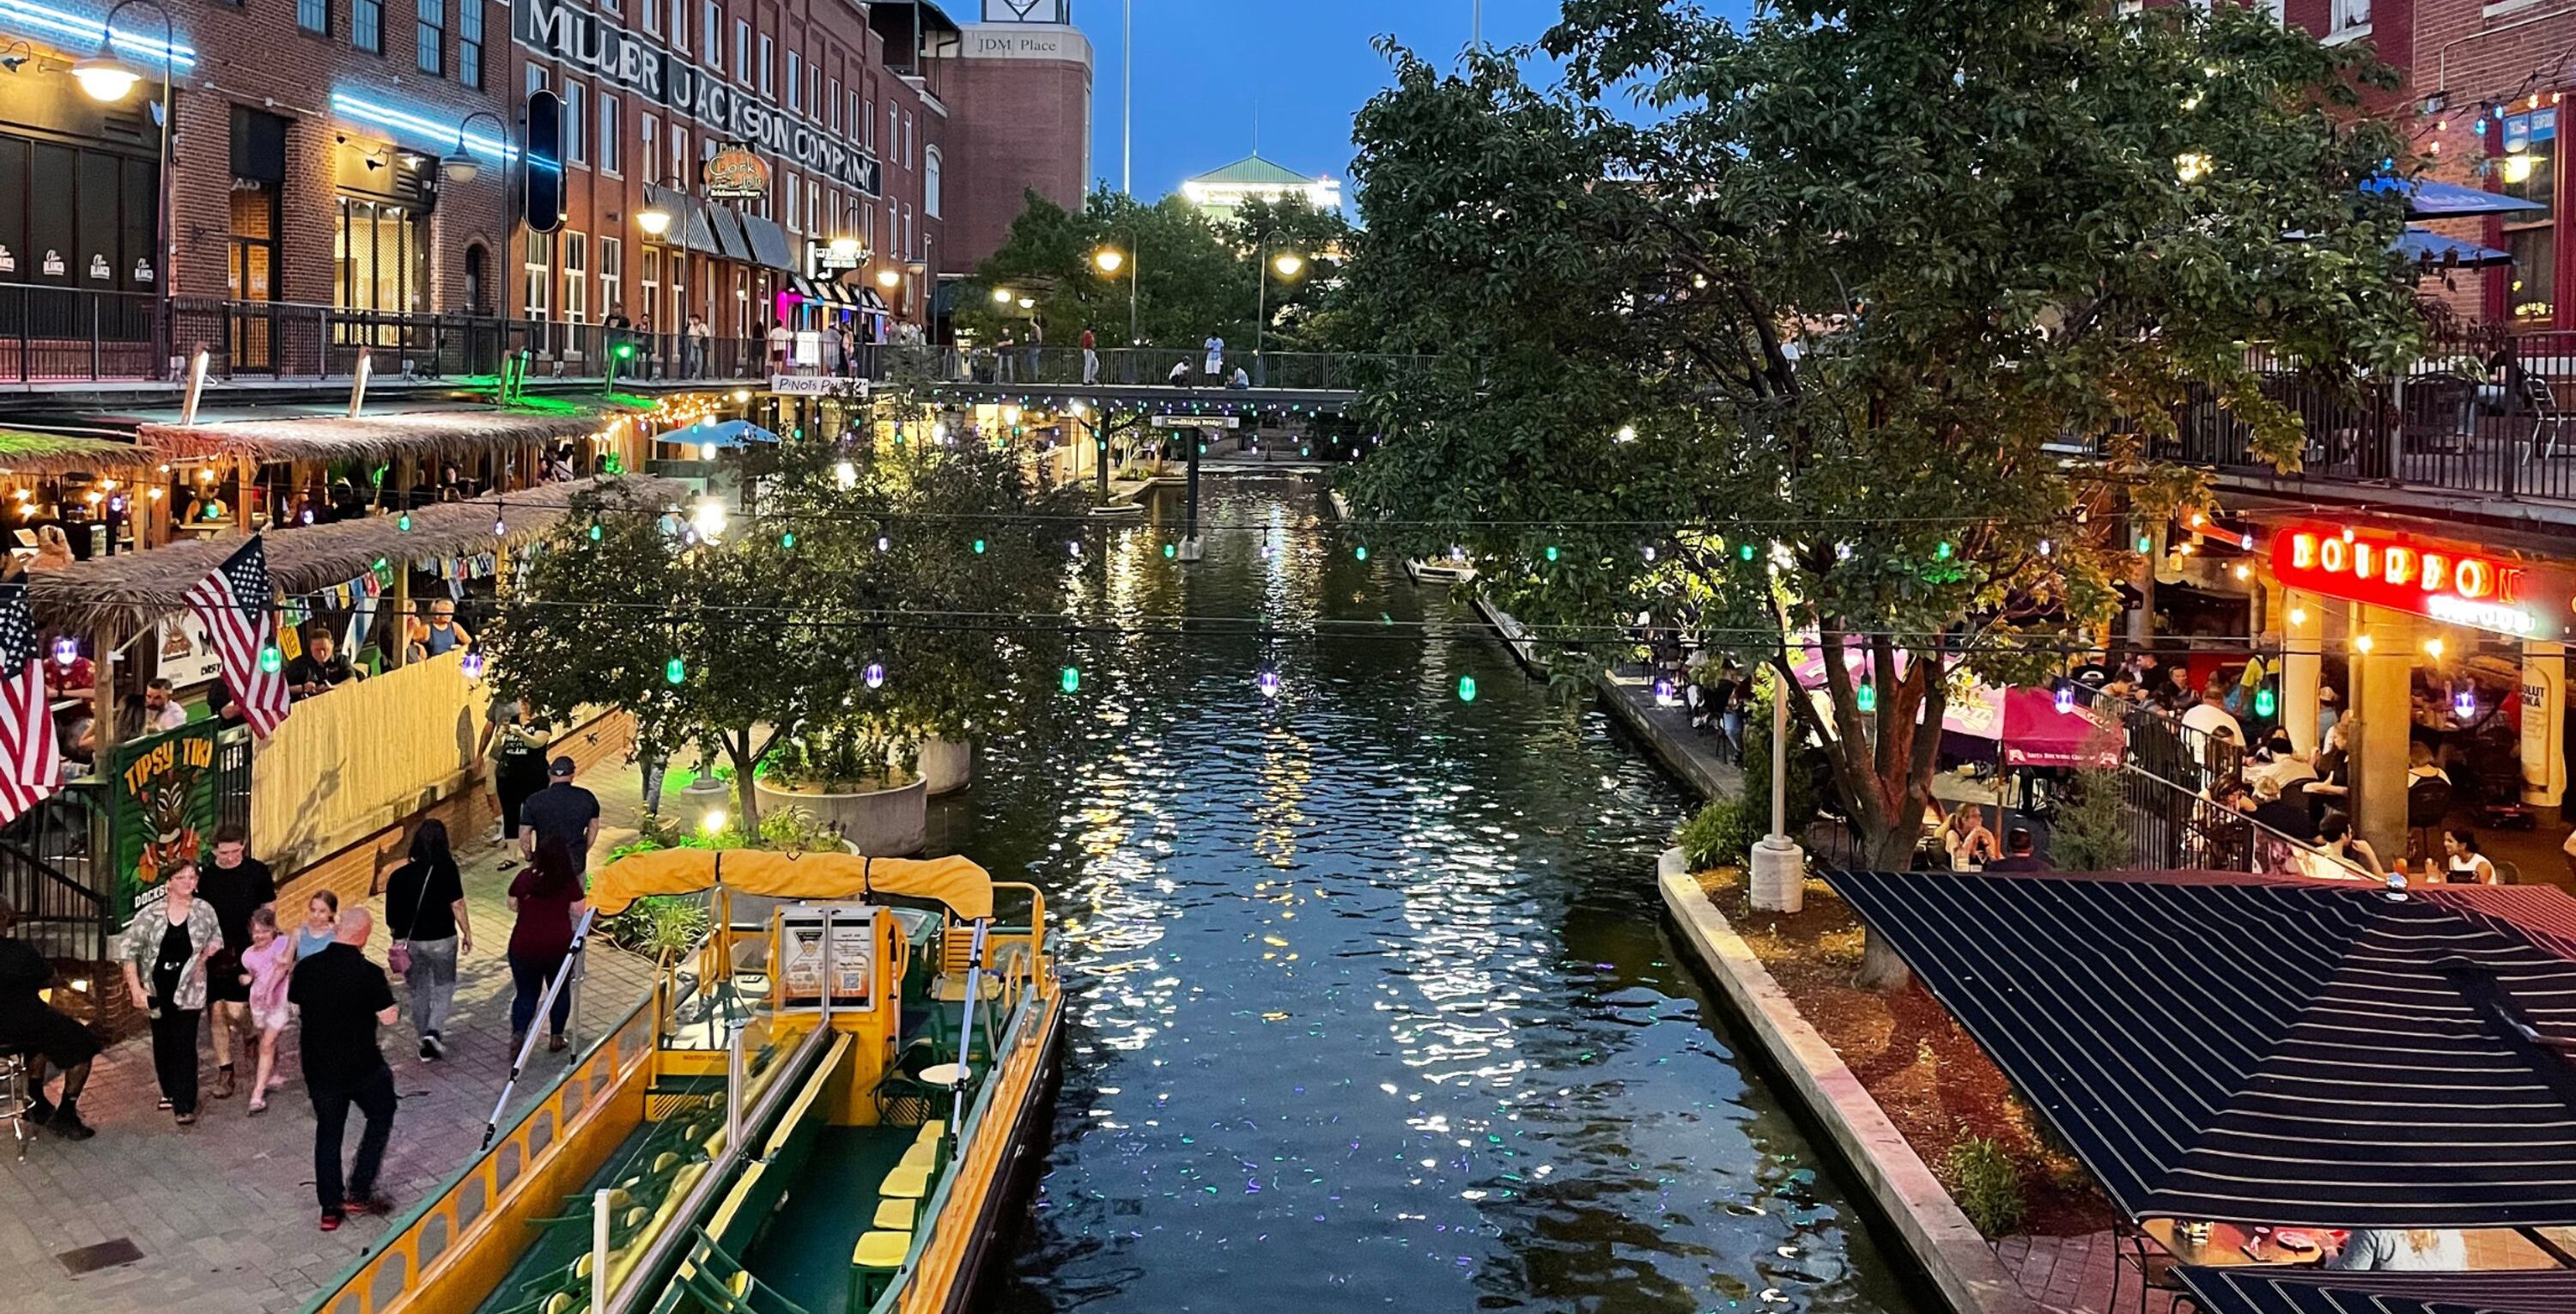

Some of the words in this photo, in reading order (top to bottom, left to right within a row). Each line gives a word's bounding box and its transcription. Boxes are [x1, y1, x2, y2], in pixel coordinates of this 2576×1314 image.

[978, 38, 1012, 53] JDM
[1021, 39, 1057, 52] Place
[529, 0, 660, 95] MILLER
[674, 72, 789, 152] JACKSON
[794, 128, 872, 191] COMPANY
[709, 156, 756, 176] Cork
[124, 739, 174, 796] TIPSY
[182, 738, 213, 769] TIKI
